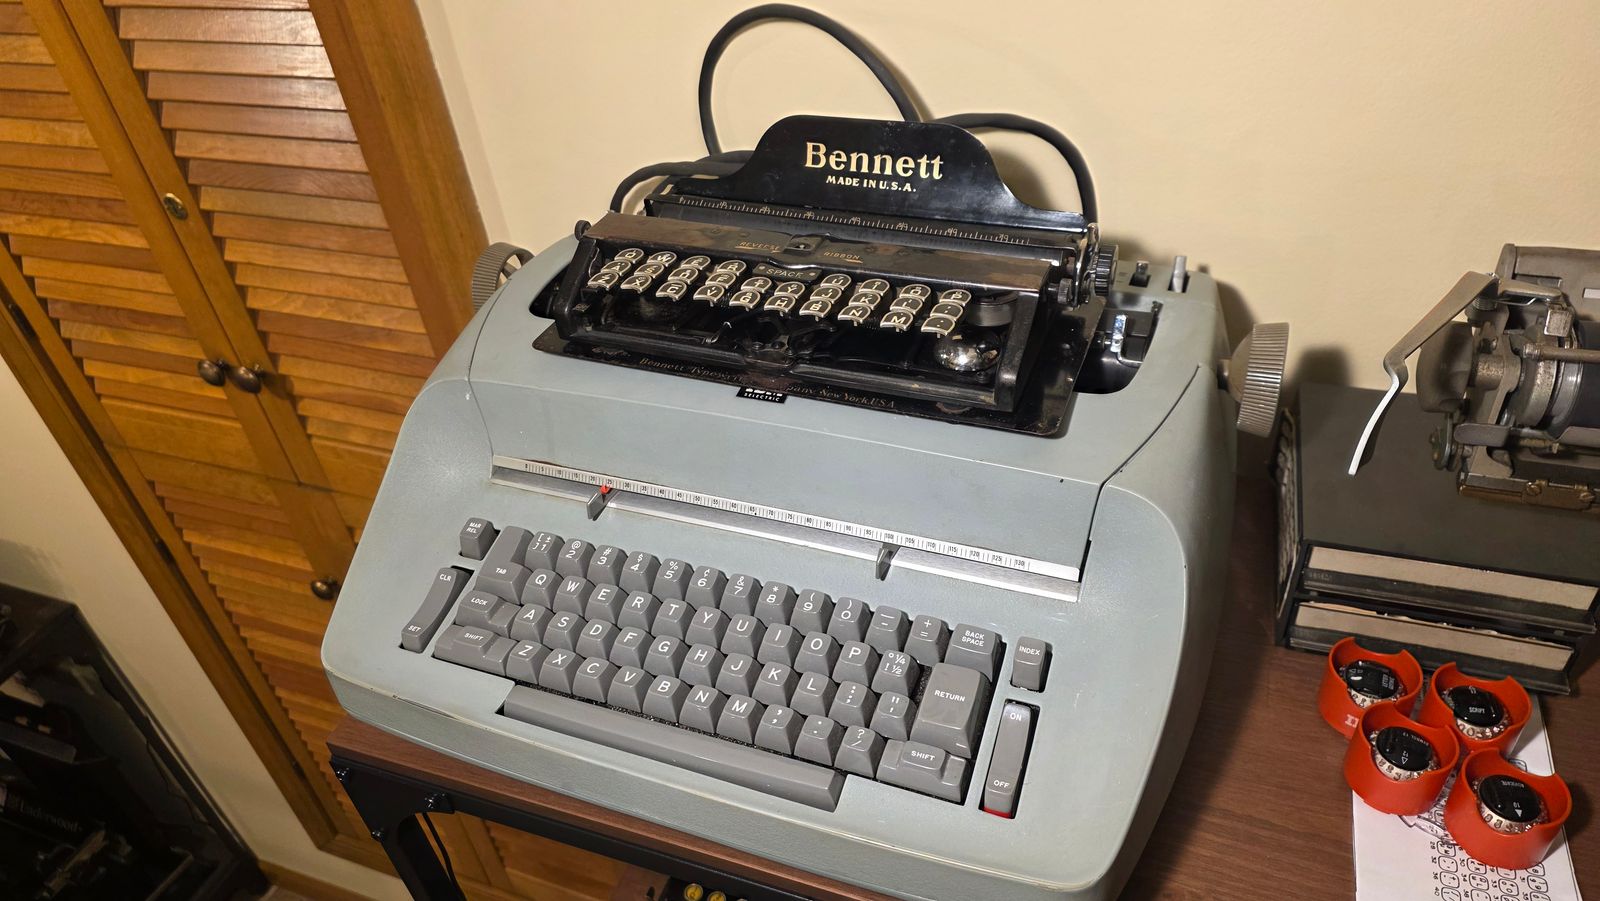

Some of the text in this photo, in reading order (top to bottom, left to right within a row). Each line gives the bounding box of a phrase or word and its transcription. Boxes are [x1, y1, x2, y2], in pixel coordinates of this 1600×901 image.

[804, 141, 944, 180] Bennett
[826, 175, 917, 193] MADE IN U.S.A.
[739, 241, 781, 252] REVERSE
[823, 251, 861, 260] RIBBON
[766, 268, 805, 278] SPACE
[639, 358, 684, 371] Bennett
[743, 391, 781, 402] SELECTRIC
[572, 540, 582, 550] @
[566, 550, 576, 558] 2
[602, 548, 612, 556] #
[598, 554, 608, 564] 3
[670, 560, 678, 570] %
[440, 574, 452, 582] CLR
[664, 570, 674, 578] 5
[536, 574, 546, 586] Q
[698, 578, 708, 586] 6
[566, 580, 580, 592] W
[734, 584, 744, 594] 7
[598, 588, 610, 600] E
[766, 594, 776, 604] 8
[470, 598, 488, 606] LOCK
[632, 596, 644, 608] R
[802, 602, 812, 612] 9
[522, 610, 536, 620] A
[668, 604, 680, 616] T
[840, 610, 852, 620] 0
[558, 616, 570, 628] S
[704, 612, 714, 624] Y
[590, 624, 602, 634] D
[736, 620, 748, 632] U
[464, 632, 484, 640] SHIFT
[624, 632, 638, 642] F
[774, 630, 782, 640] I
[964, 629, 985, 641] BACK
[658, 640, 670, 652] G
[810, 638, 822, 650] O
[961, 636, 985, 648] SPACE
[518, 644, 532, 656] Z
[848, 646, 862, 658] P
[1018, 646, 1040, 656] INDEX
[552, 654, 566, 664] X
[694, 650, 708, 662] H
[586, 662, 600, 674] C
[730, 660, 744, 670] J
[624, 672, 636, 682] V
[768, 668, 782, 680] K
[658, 680, 670, 692] B
[806, 678, 816, 690] L
[694, 690, 710, 702] N
[934, 690, 966, 702] RETURN
[732, 700, 748, 712] M
[1010, 710, 1024, 720] ON
[912, 750, 936, 760] SHIFT
[994, 780, 1010, 788] OFF
